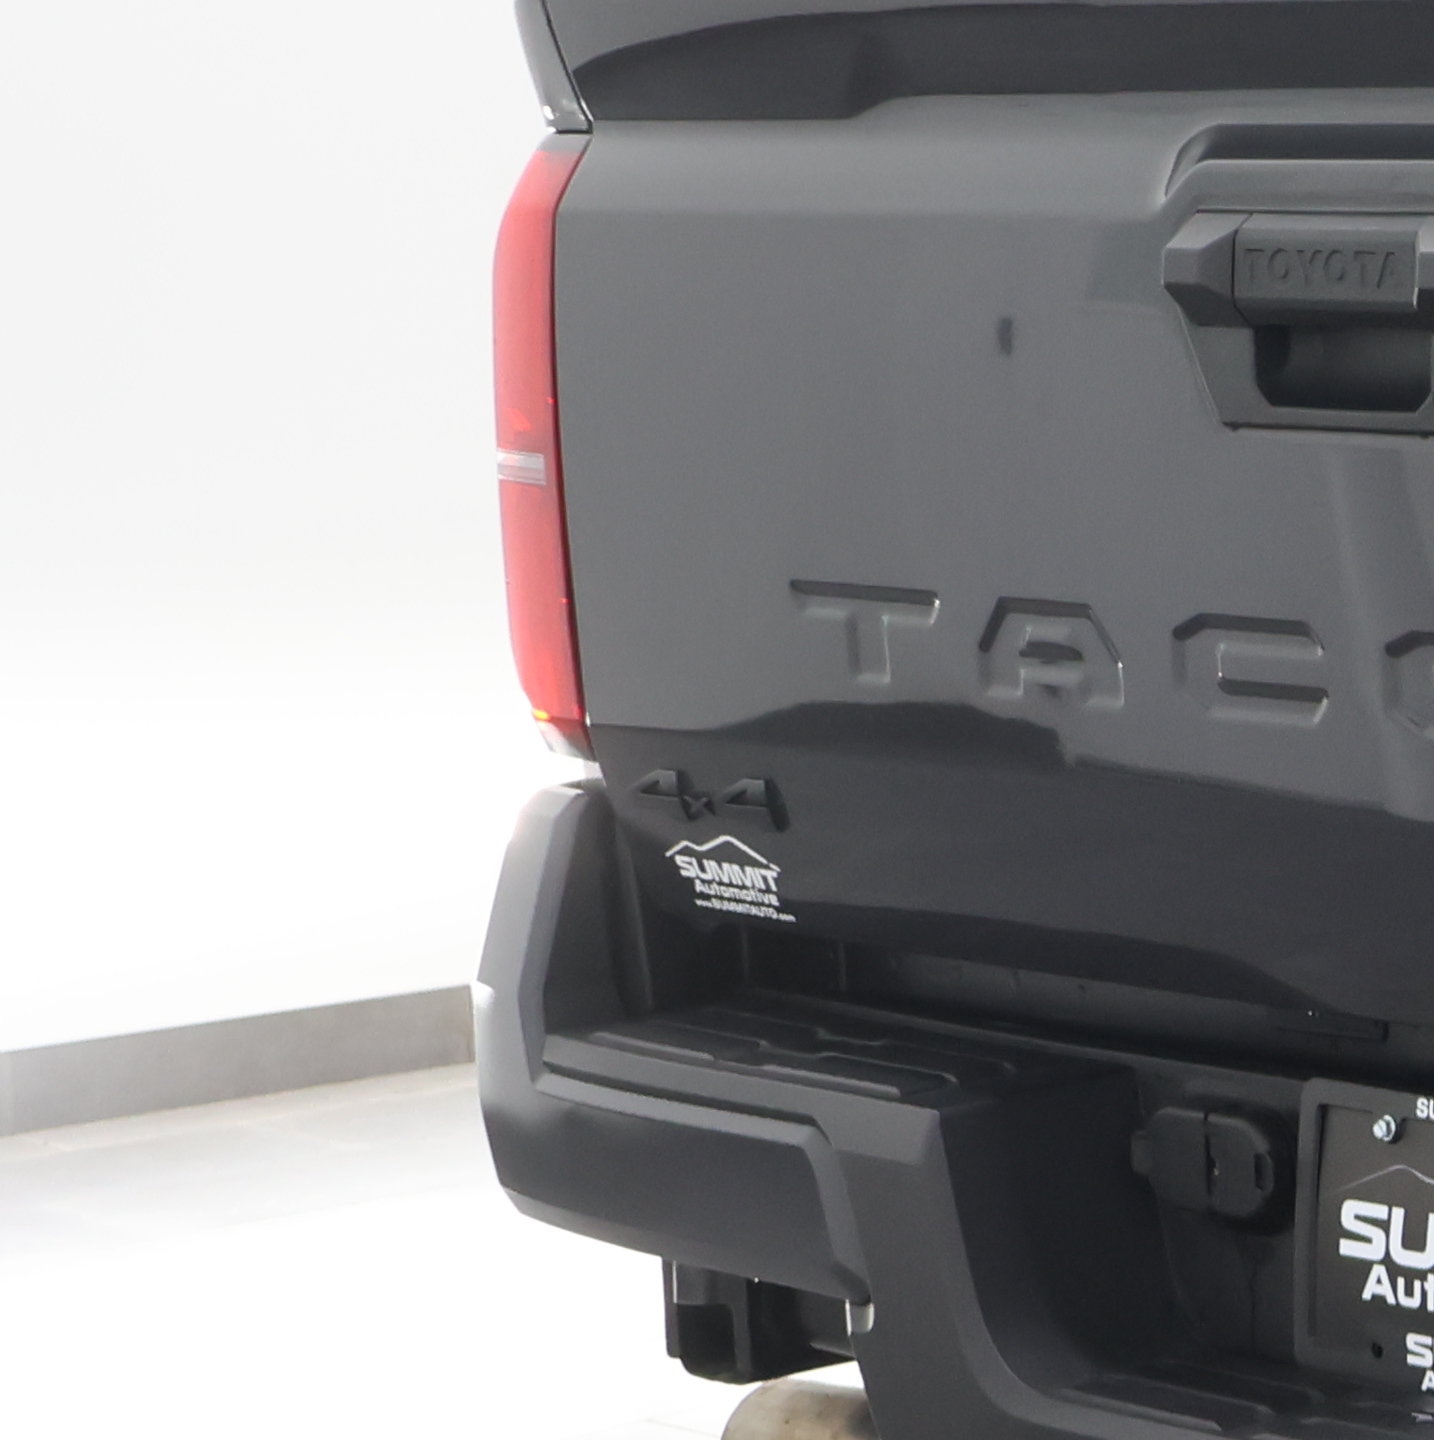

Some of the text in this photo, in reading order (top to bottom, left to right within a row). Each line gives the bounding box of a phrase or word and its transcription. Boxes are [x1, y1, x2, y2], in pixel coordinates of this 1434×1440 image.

[1243, 247, 1400, 289] TOYOTA
[674, 854, 779, 892] SUMMIT
[694, 879, 780, 906] Automotive
